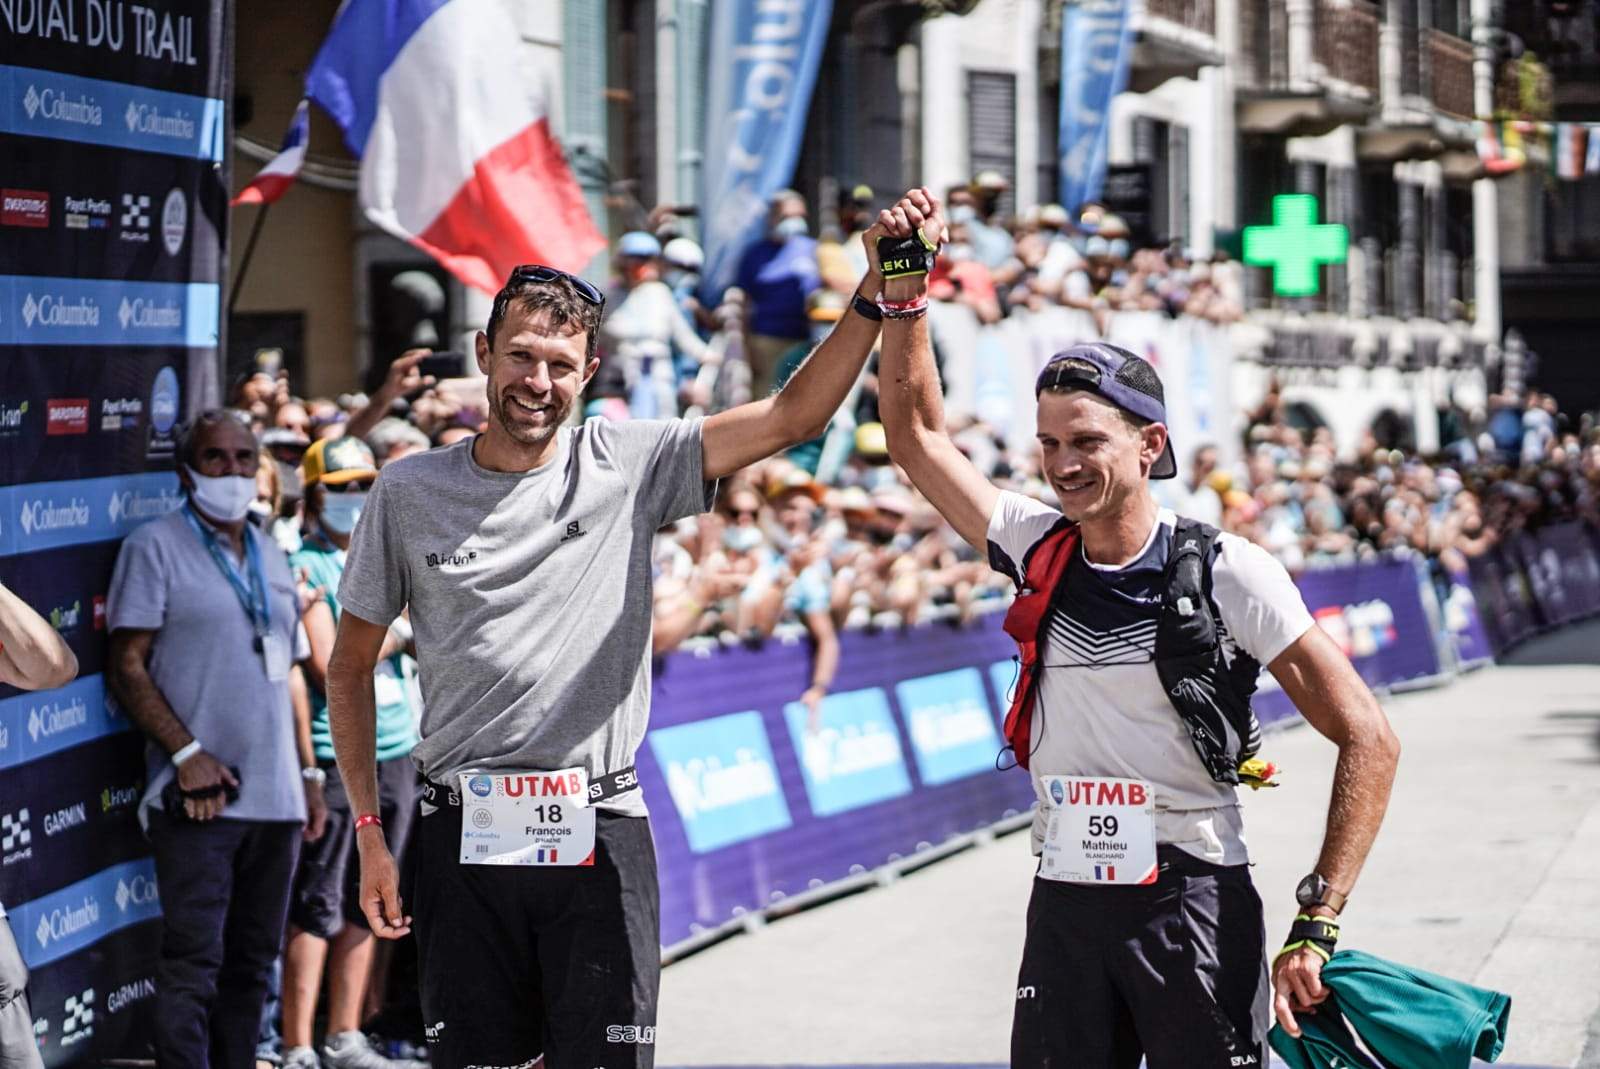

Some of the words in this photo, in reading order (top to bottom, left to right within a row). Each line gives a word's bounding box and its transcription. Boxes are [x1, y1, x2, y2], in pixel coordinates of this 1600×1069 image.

[86, 0, 123, 50] DU
[131, 5, 197, 65] TRAIL
[40, 88, 102, 126] Columbia
[138, 103, 194, 139] Columbia
[38, 294, 99, 326] Columbia
[131, 297, 182, 327] Columbia
[32, 498, 90, 530] Columbia
[40, 697, 86, 737] Columbia
[505, 774, 581, 798] UTMB
[1068, 781, 1146, 806] UTMB
[44, 802, 86, 836] GARMIN
[535, 804, 563, 823] 18
[1089, 815, 1118, 837] 59
[525, 825, 572, 838] François
[1082, 839, 1128, 851] Mathieu
[1085, 852, 1125, 860] BLANCHARD
[49, 895, 99, 941] Columbia
[107, 978, 156, 1013] GARMIN
[607, 1024, 657, 1043] salo
